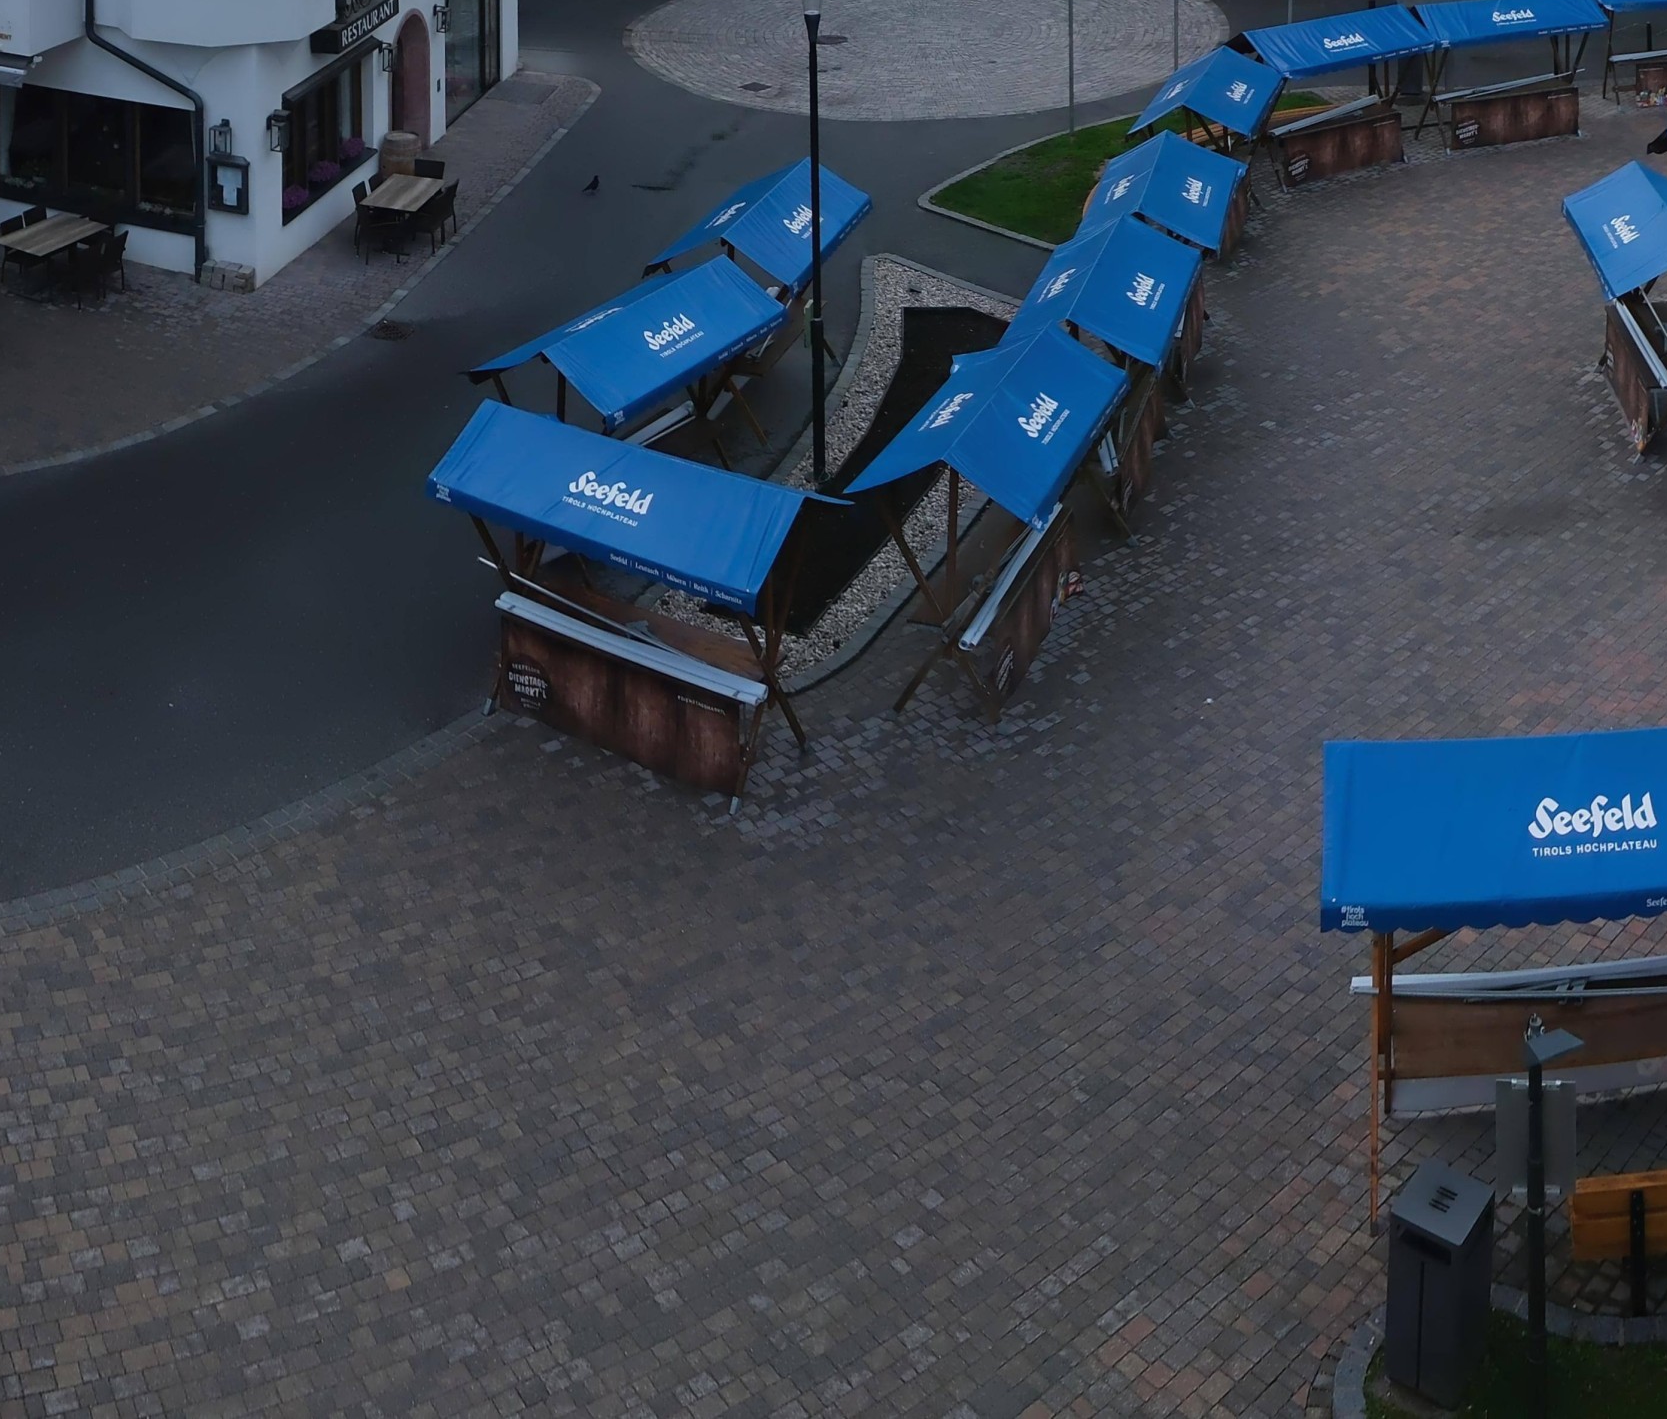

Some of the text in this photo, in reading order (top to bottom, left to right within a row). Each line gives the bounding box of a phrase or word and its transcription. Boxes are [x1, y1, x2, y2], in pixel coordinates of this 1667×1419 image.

[1492, 9, 1535, 22] Seefeld
[1324, 34, 1365, 49] Seefeld
[644, 314, 696, 351] Seefeld
[1021, 393, 1059, 438] Seefeld
[569, 471, 654, 515] Seefeld
[562, 496, 638, 527] TIROLS HOCHPLATEAU
[508, 671, 548, 689] DIENSTAGS-
[514, 684, 547, 699] MARKT'L
[1528, 792, 1658, 838] Seefeld
[1532, 839, 1658, 857] TIROLS HOCHPLATEAU
[1341, 919, 1369, 928] plateau
[1345, 912, 1364, 921] hoch
